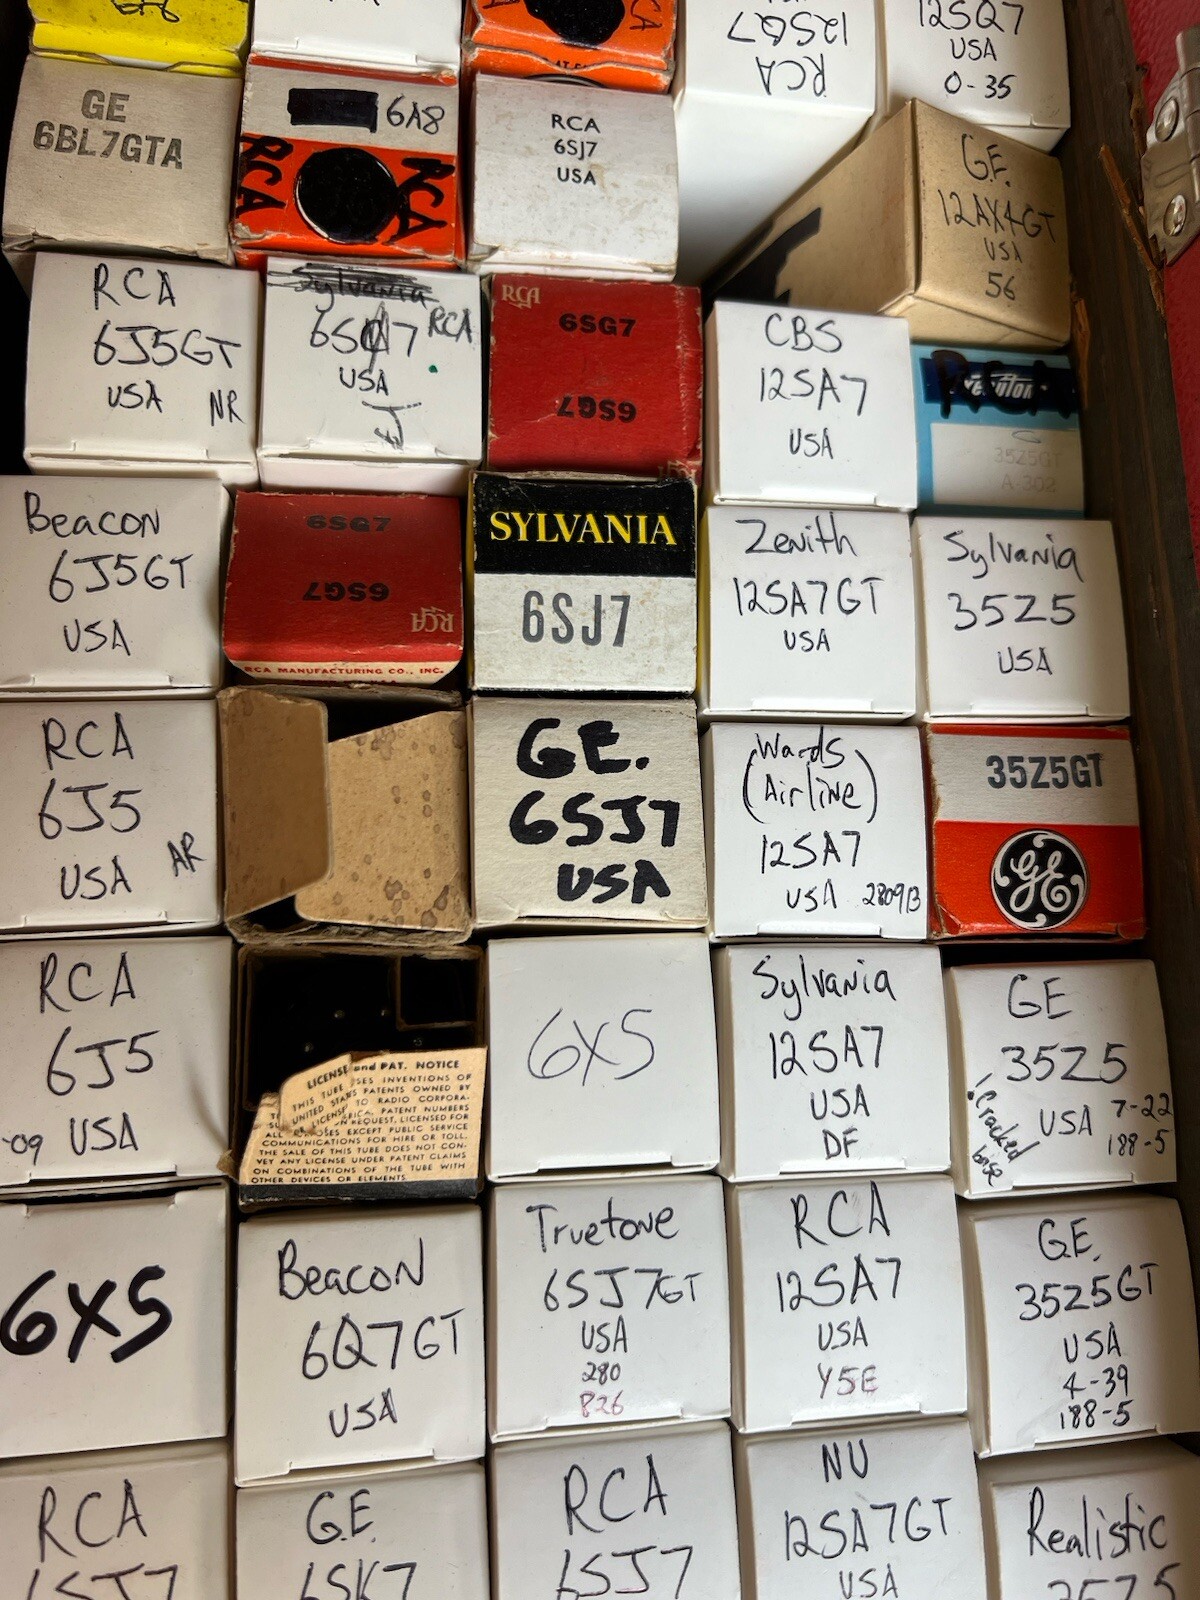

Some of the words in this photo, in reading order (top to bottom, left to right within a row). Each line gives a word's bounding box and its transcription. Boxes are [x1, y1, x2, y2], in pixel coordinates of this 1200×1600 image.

[727, 11, 848, 47] 12SQ7
[919, 0, 1025, 35] 12SQ7
[950, 37, 999, 62] USA
[756, 53, 827, 97] RCA
[81, 89, 130, 123] GE
[386, 94, 445, 135] 6A8
[551, 114, 601, 134] RCA
[33, 120, 183, 170] 6BL7GTA
[553, 139, 599, 158] 6SJ7
[556, 167, 597, 186] USA
[937, 188, 1057, 244] 12AX4GT
[983, 237, 1023, 264] USA
[94, 262, 176, 310] RCA
[501, 284, 541, 309] RCA
[985, 271, 1016, 301] 56
[93, 319, 242, 369] 6J5GT
[428, 305, 473, 344] RCA
[559, 312, 637, 338] 6SG7
[764, 312, 843, 353] CBS
[107, 379, 164, 413] USA
[339, 366, 389, 396] USA
[759, 366, 868, 416] 12SA7
[209, 389, 244, 427] NR
[556, 395, 637, 424] 6SG7
[788, 427, 835, 460] USA
[994, 447, 1063, 468] 35Z5GT
[24, 490, 161, 537] Beacon
[489, 511, 678, 547] SYLVANIA
[734, 510, 857, 557] Zenith
[49, 548, 194, 603] 6J5GT
[942, 530, 1085, 582] Sylvania
[303, 581, 391, 602] 6SG7
[732, 576, 885, 617] 12SA7GT
[411, 605, 455, 634] RCA
[521, 589, 632, 648] 6SJ7
[947, 592, 1077, 632] 35Z5
[64, 618, 132, 657] USA
[783, 629, 831, 653] USA
[277, 667, 383, 675] MANUFACTURING
[996, 645, 1053, 676] USA
[42, 711, 135, 770] RCA
[985, 753, 1105, 789] 35Z5GT
[38, 777, 143, 840] 6J5
[509, 790, 681, 847] 6SJ7
[167, 831, 207, 877] AR
[761, 830, 862, 874] 12SA7
[60, 854, 133, 900] USA
[556, 858, 672, 904] USA
[787, 878, 838, 912] USA
[39, 951, 137, 1014] RCA
[752, 954, 897, 1021] Sylvania
[1007, 973, 1073, 1019] GE
[46, 1026, 161, 1096] 6J5
[526, 1008, 655, 1086] 6X5
[769, 1025, 885, 1080] 12SA7
[1001, 1042, 1128, 1085] 35Z5
[291, 1096, 315, 1112] THIS
[321, 1083, 344, 1099] TUBE
[383, 1075, 450, 1084] INVENTIONS
[457, 1073, 472, 1081] OF
[307, 1064, 349, 1090] LICENSE
[354, 1062, 376, 1072] and
[380, 1061, 407, 1071] PAT.
[416, 1060, 460, 1069] NOTICE
[292, 1105, 324, 1125] UNITED
[364, 1086, 405, 1094] PATENTS
[413, 1084, 451, 1093] OWNED
[356, 1098, 368, 1106] TO
[378, 1096, 410, 1104] RADIO
[381, 1106, 417, 1114] PATENT
[424, 1104, 470, 1113] NUMBERS
[400, 1113, 447, 1123] LICENSED
[809, 1083, 871, 1119] USA
[1039, 1103, 1093, 1138] USA
[1110, 1092, 1174, 1123] 7-22
[70, 1111, 139, 1156] USA
[262, 1137, 361, 1147] COMMUNICATIONS
[367, 1136, 387, 1144] FOR
[347, 1127, 382, 1136] EXCEPT
[389, 1125, 424, 1134] PUBLIC
[430, 1123, 468, 1131] SERVICE
[822, 1127, 859, 1160] DF
[1107, 1128, 1171, 1157] 188-5
[305, 1157, 346, 1165] LICENSE
[351, 1156, 385, 1164] UNDER
[390, 1153, 425, 1161] PATENT
[430, 1152, 467, 1160] CLAIMS
[312, 1148, 325, 1156] OF
[330, 1147, 352, 1155] THIS
[358, 1146, 380, 1154] TUBE
[363, 1166, 378, 1174] OF
[251, 1176, 284, 1184] OTHER
[525, 1196, 680, 1253] Truetone
[790, 1180, 891, 1250] RCA
[278, 1238, 426, 1300] Beacon
[543, 1266, 703, 1312] 6SJ7GT
[776, 1253, 902, 1313] 12SA7
[1015, 1262, 1160, 1321] 35Z5GT
[0, 1264, 173, 1364] 6X5
[580, 1314, 629, 1354] USA
[817, 1316, 869, 1352] USA
[301, 1308, 466, 1380] 6Q7GT
[1063, 1321, 1123, 1364] USA
[581, 1361, 622, 1383] 280
[817, 1362, 879, 1399] Y5E
[1062, 1363, 1129, 1400] 4-39
[329, 1387, 399, 1438] USA
[1060, 1399, 1134, 1431] 188-5
[821, 1438, 869, 1483] NU
[564, 1453, 668, 1536] RCA
[38, 1478, 148, 1562] RCA
[785, 1496, 952, 1561] 12SA7GT
[1027, 1486, 1168, 1561] Realistic
[556, 1545, 693, 1600] 6SJ7
[838, 1563, 898, 1599] USA
